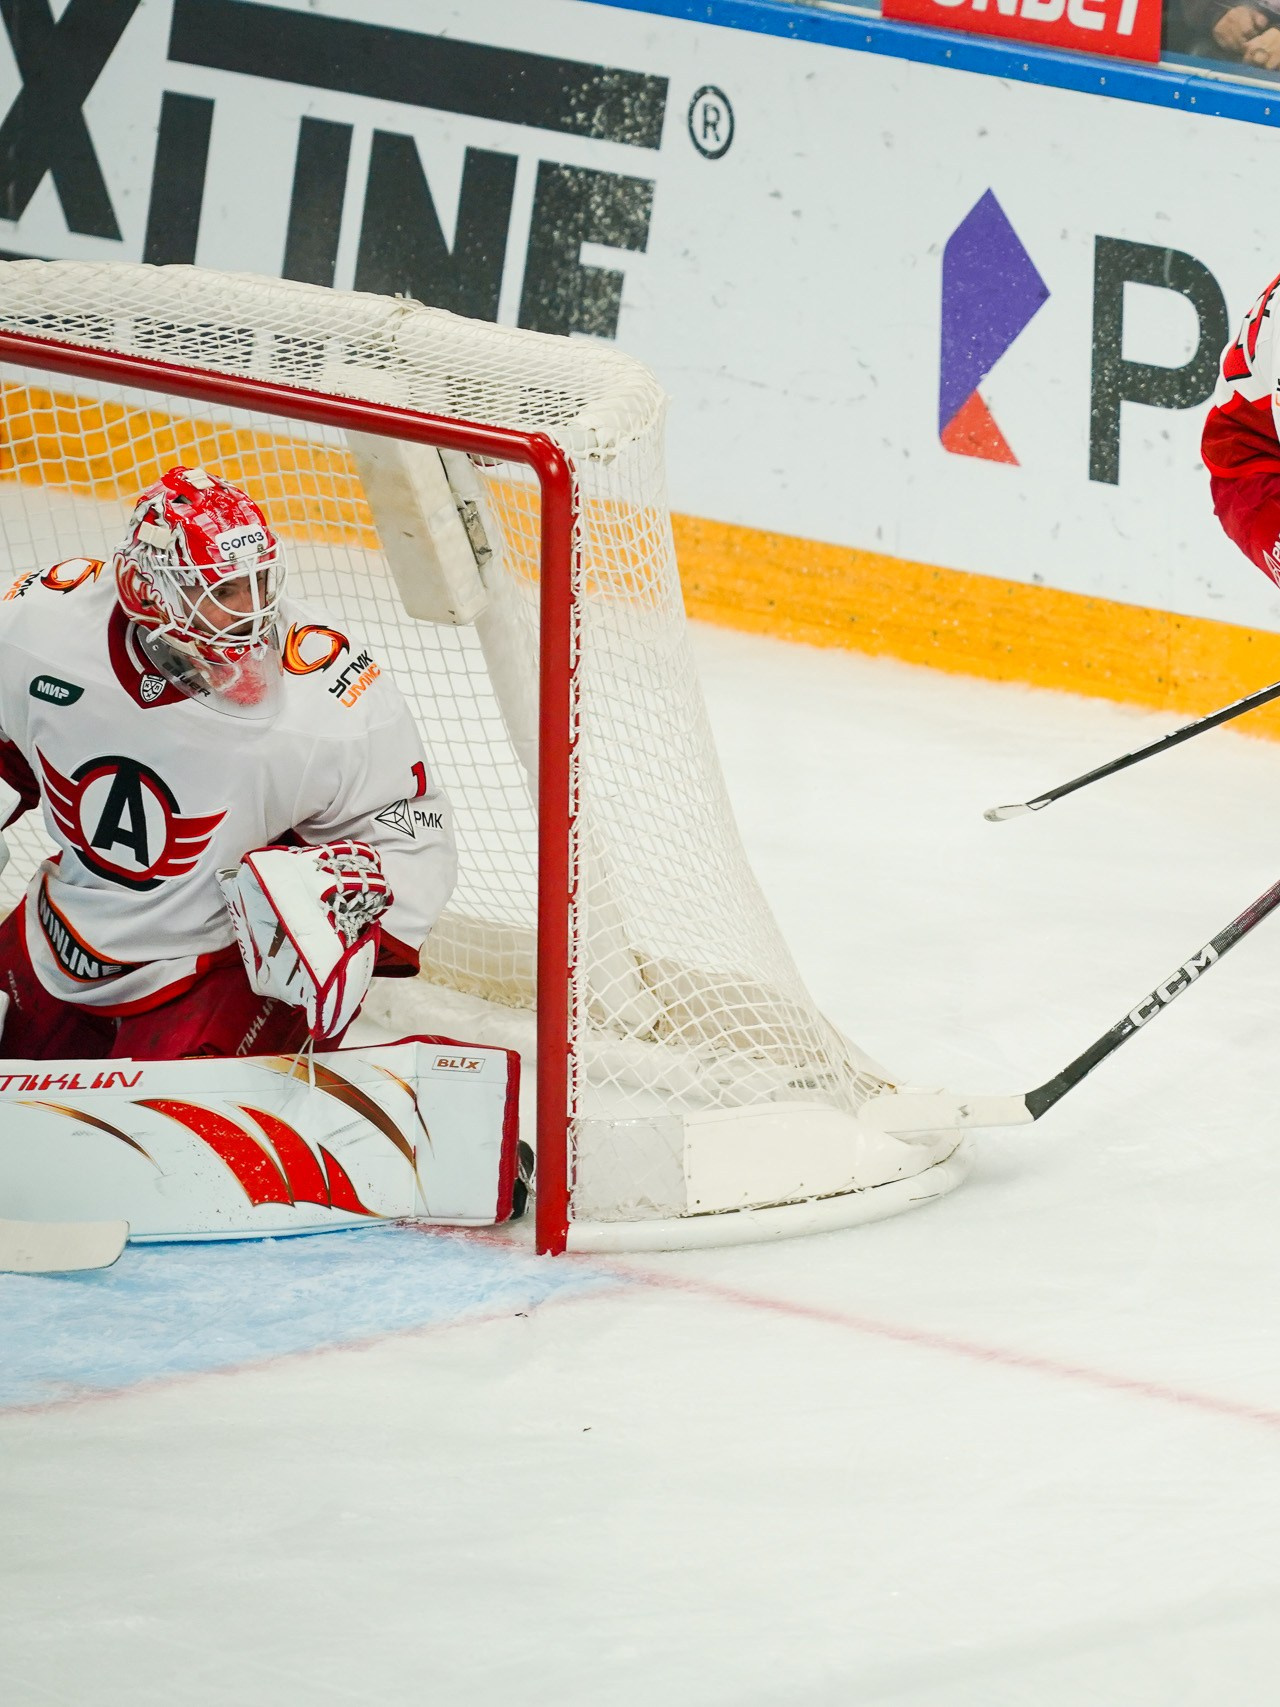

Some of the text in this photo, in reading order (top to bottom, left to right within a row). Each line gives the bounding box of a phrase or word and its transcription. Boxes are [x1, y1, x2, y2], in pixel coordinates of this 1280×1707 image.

[220, 531, 264, 551] согаз
[328, 650, 374, 698] УГМК
[1129, 944, 1219, 1027] CCM
